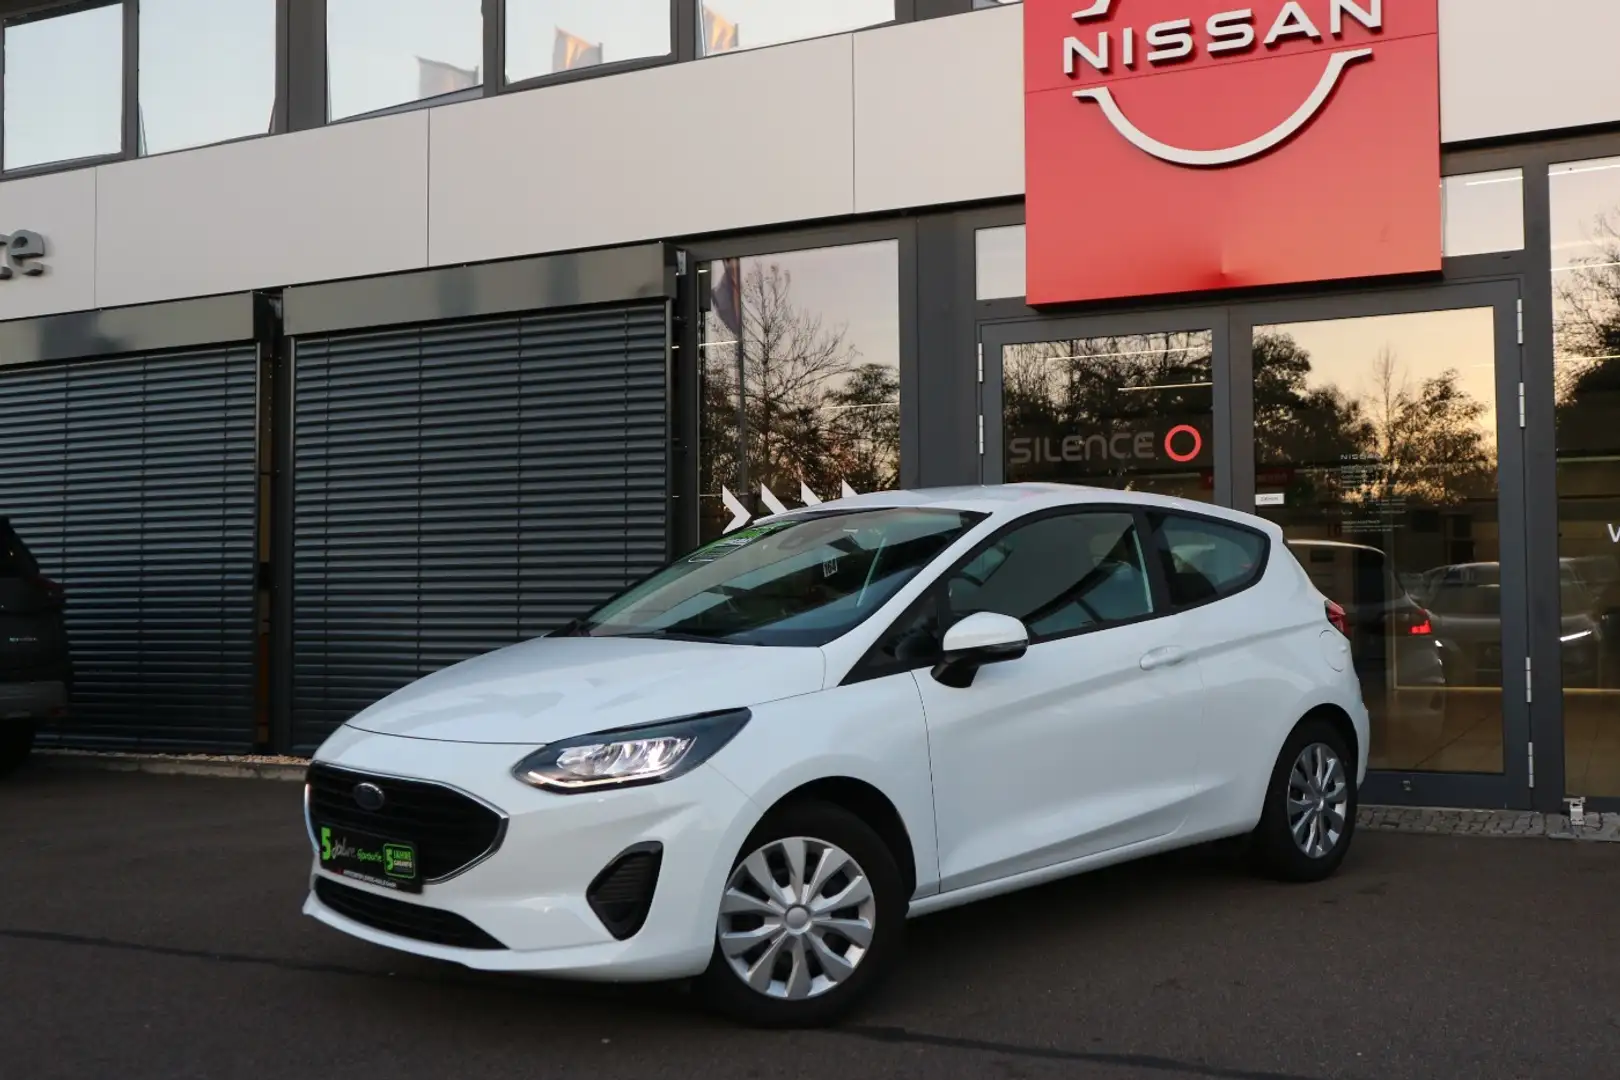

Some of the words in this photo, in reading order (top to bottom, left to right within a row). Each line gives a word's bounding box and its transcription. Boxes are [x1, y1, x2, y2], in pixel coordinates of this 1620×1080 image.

[1063, 0, 1383, 74] NISSAN
[1008, 431, 1156, 464] SILENCE
[320, 826, 332, 860] 5
